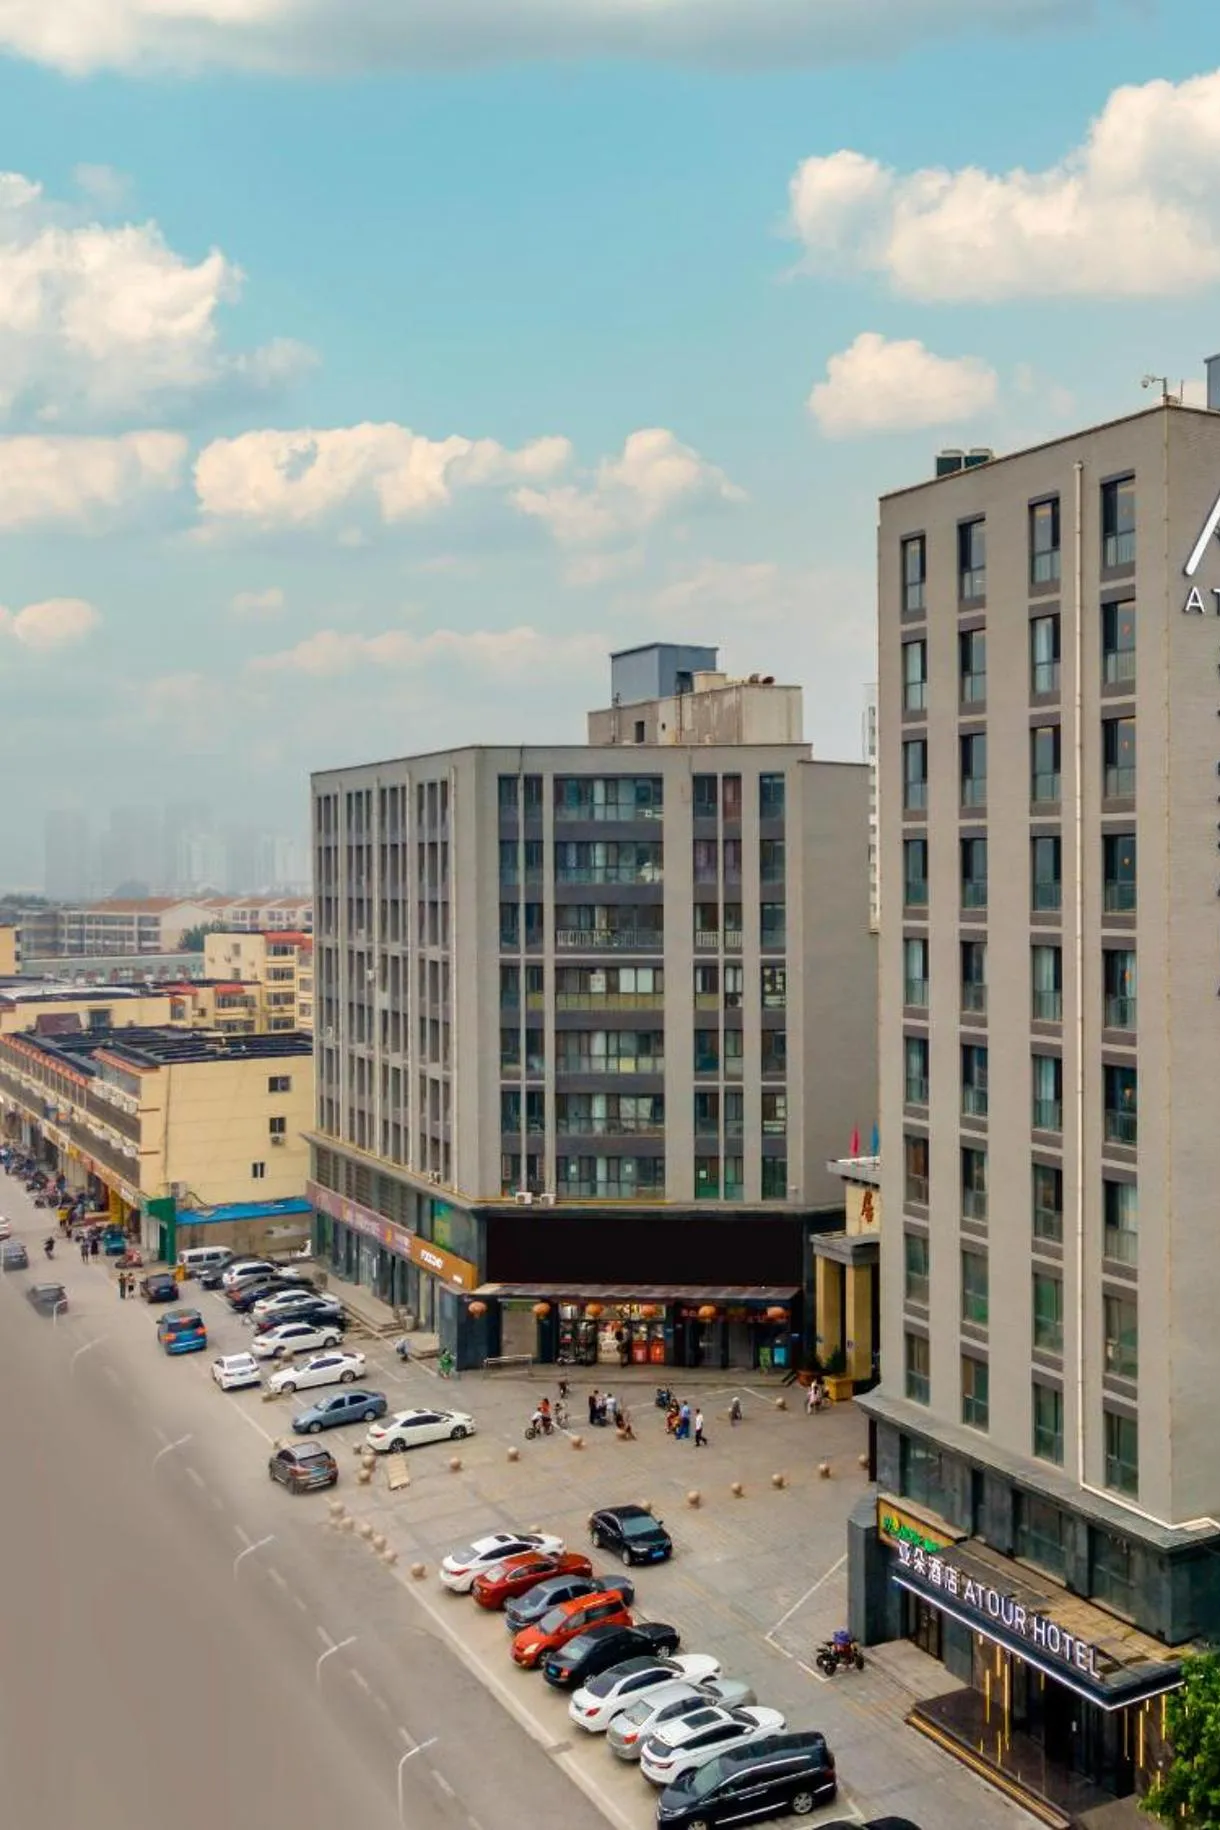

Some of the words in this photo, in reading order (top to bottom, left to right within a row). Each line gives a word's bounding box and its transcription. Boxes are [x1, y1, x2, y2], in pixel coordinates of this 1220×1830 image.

[898, 1539, 957, 1594] 亚朵酒店
[963, 1579, 1026, 1635] ATOUR
[1033, 1615, 1101, 1679] HOTEL
